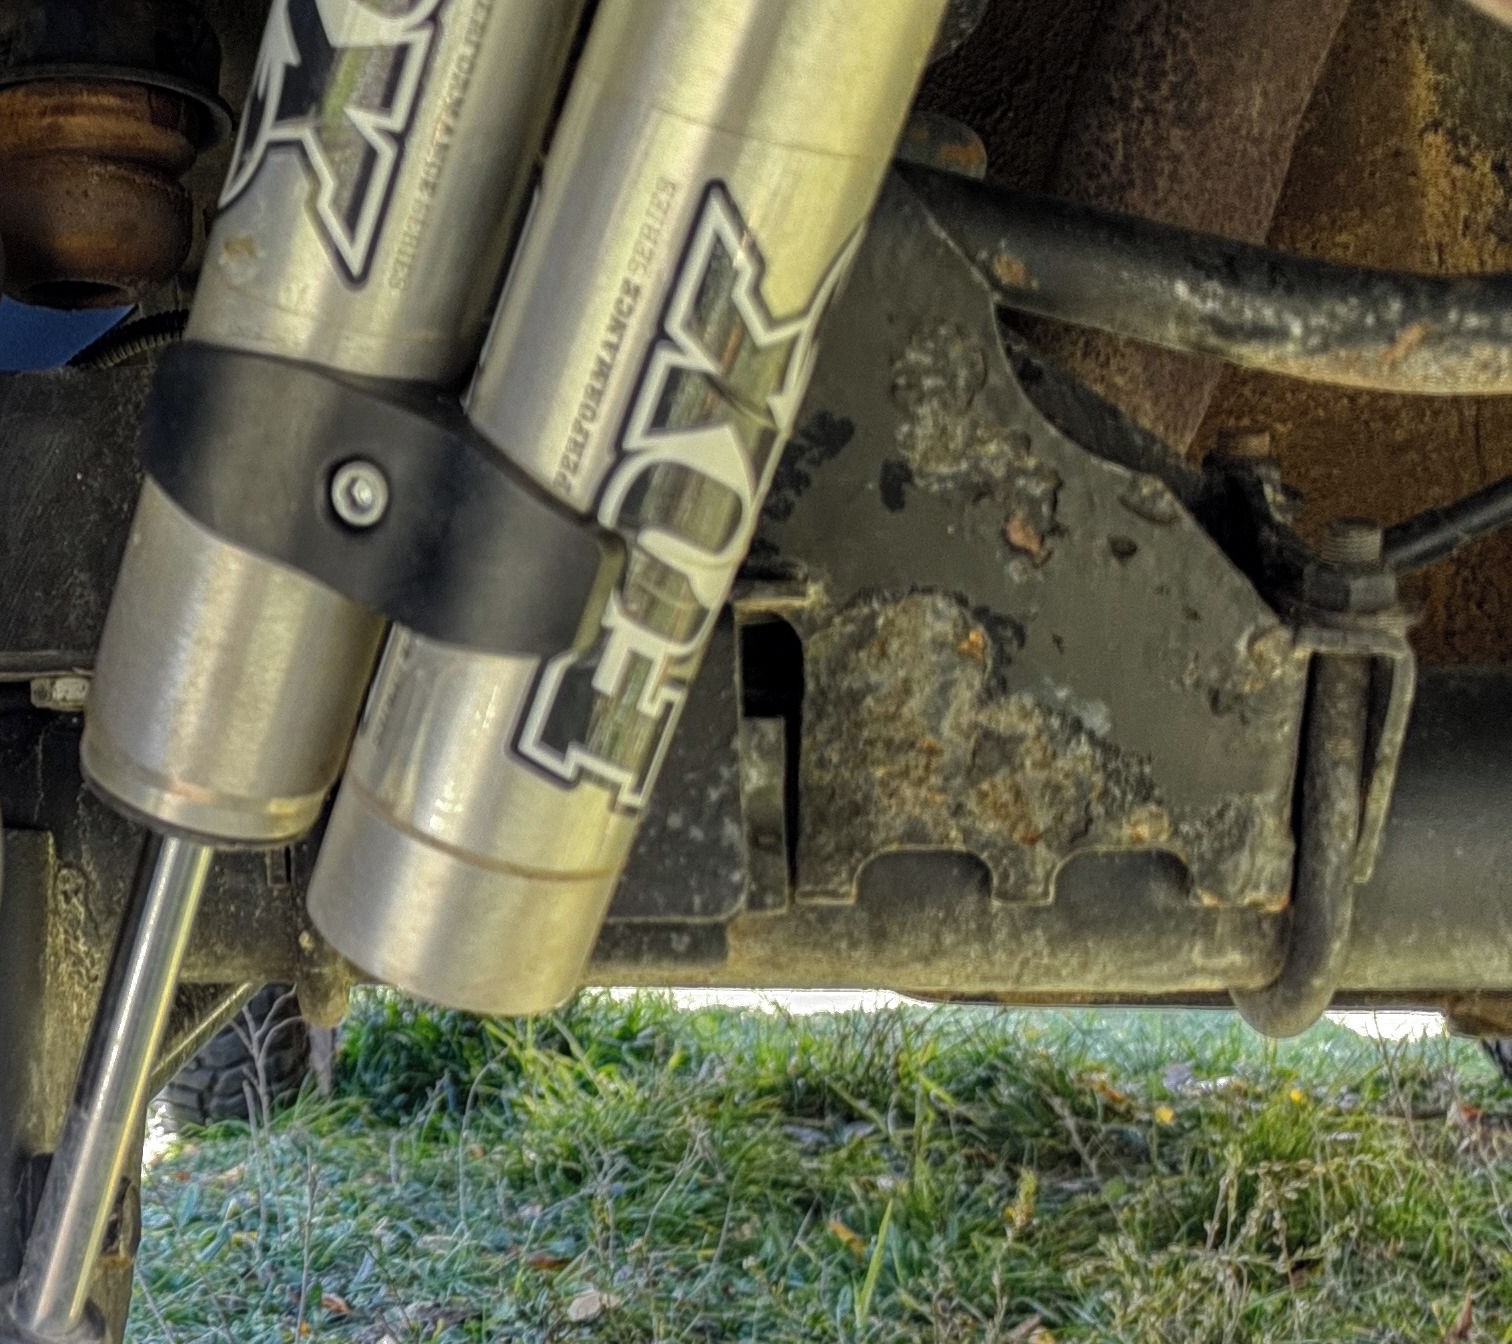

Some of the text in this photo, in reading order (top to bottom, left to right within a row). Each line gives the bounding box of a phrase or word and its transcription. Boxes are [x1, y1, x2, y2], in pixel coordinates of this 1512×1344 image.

[387, 199, 429, 292] SERIES
[552, 176, 677, 496] PERFORMANCE SERIES
[503, 179, 868, 818] FOX
